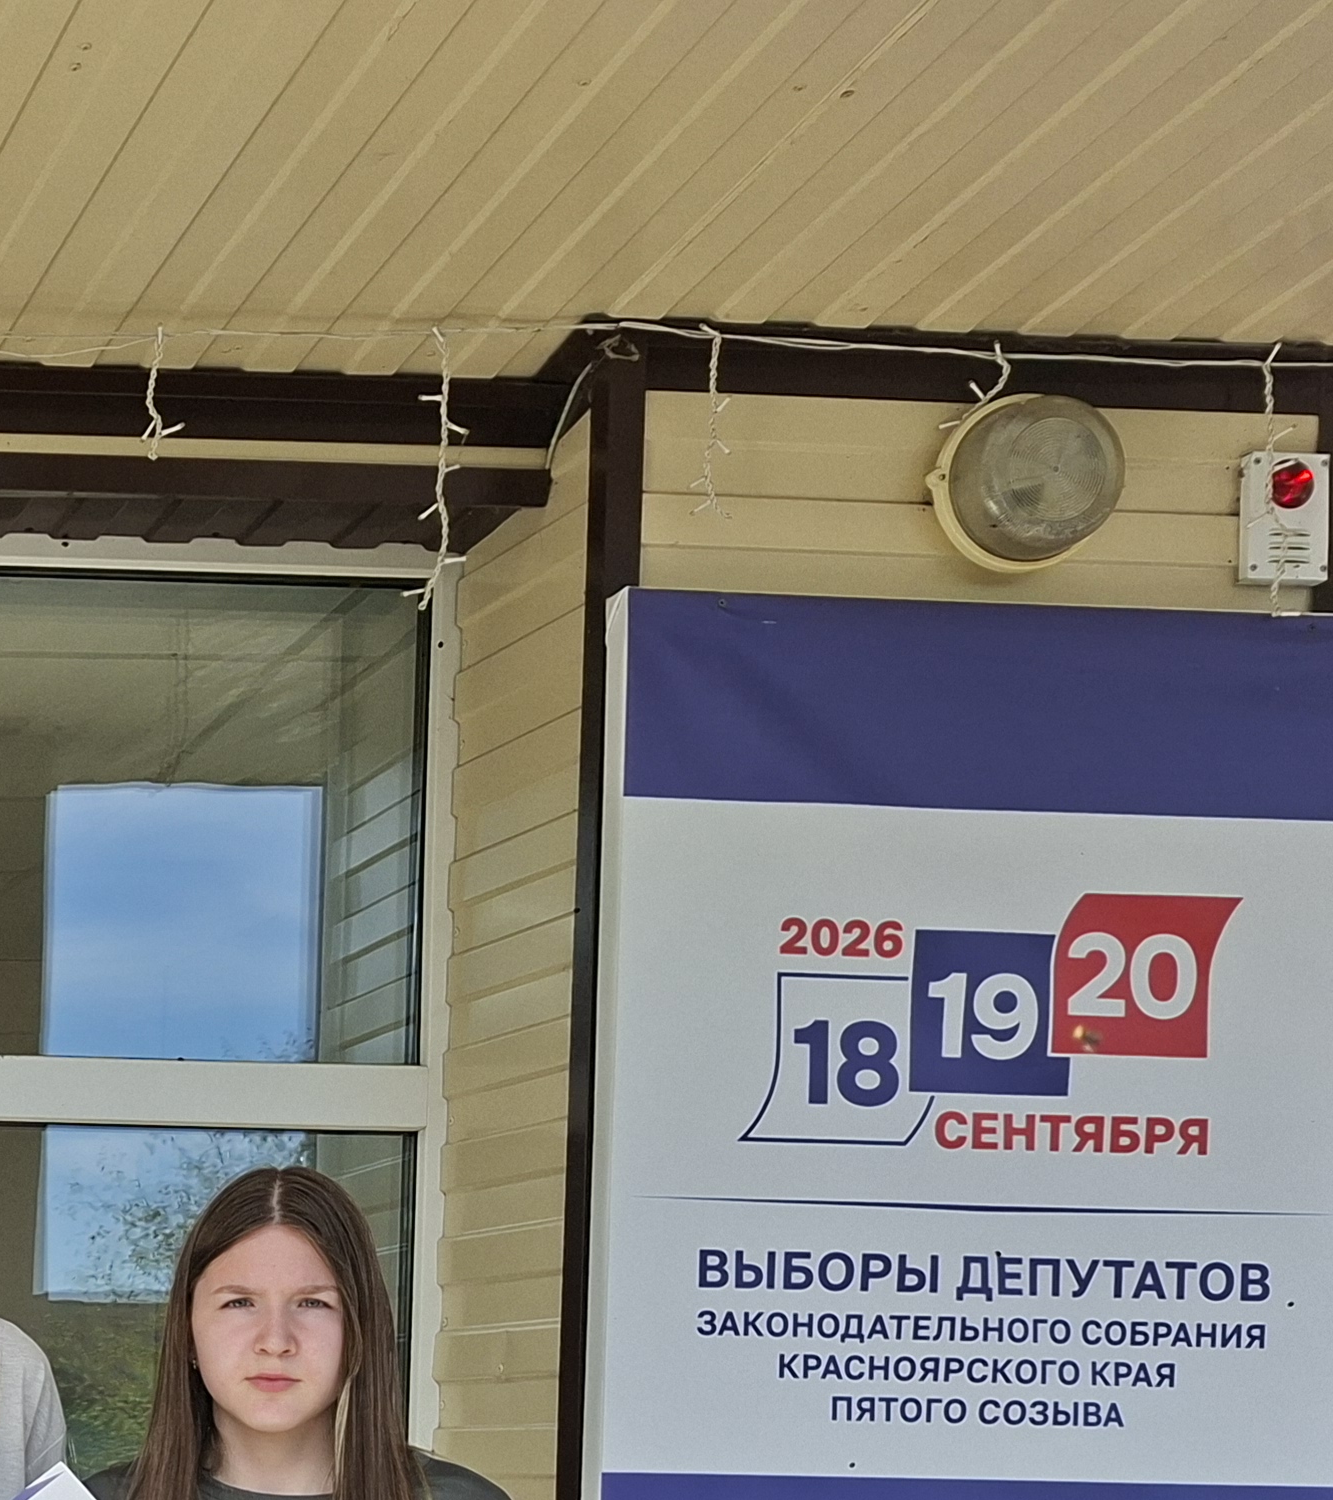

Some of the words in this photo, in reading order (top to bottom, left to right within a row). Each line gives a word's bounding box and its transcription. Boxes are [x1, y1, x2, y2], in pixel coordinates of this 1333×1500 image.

[780, 918, 902, 958] 2026
[794, 1020, 899, 1107] 18
[928, 973, 1038, 1060] 19
[1068, 932, 1197, 1019] 20
[935, 1112, 1208, 1155] СЕНТЯБРЯ
[699, 1250, 938, 1293] ВЫБОРЫ
[956, 1253, 1269, 1301] ДЕПУТАТОВ
[697, 1311, 1070, 1344] ЗАКОНОДАТЕЛЬНОГО
[1082, 1320, 1265, 1348] СОБРАНИЯ
[779, 1354, 1079, 1385] КРАСНОЯРСКОГО
[1092, 1361, 1175, 1387] КРАЯ
[832, 1396, 966, 1423] ПЯТОГО
[979, 1400, 1123, 1427] СОЗЫВА
